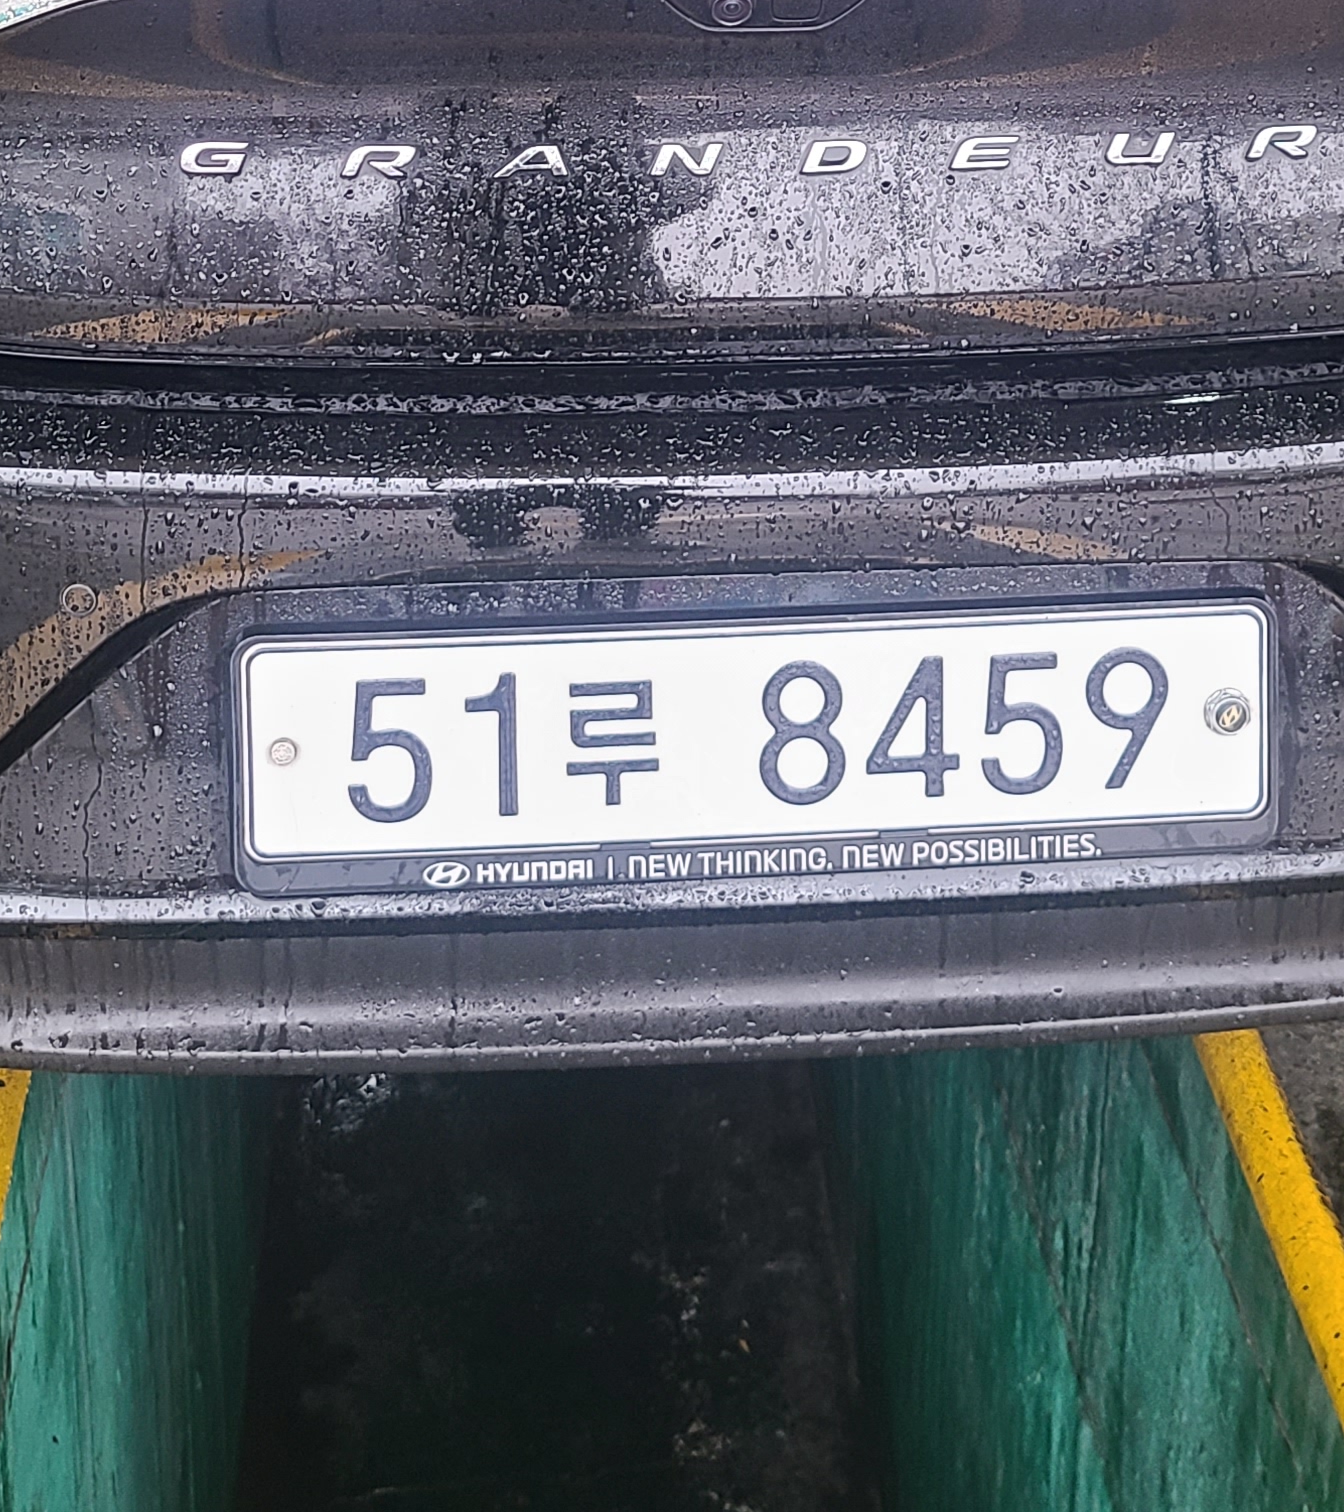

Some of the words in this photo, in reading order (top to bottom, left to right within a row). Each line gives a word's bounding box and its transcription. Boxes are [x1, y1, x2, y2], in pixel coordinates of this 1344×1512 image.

[177, 121, 1324, 182] GRANDEUR
[346, 672, 661, 825] 51루
[757, 644, 1171, 807] 8459
[475, 859, 594, 884] HYUNDAI
[628, 851, 693, 879] NEW
[843, 841, 906, 870] NEW
